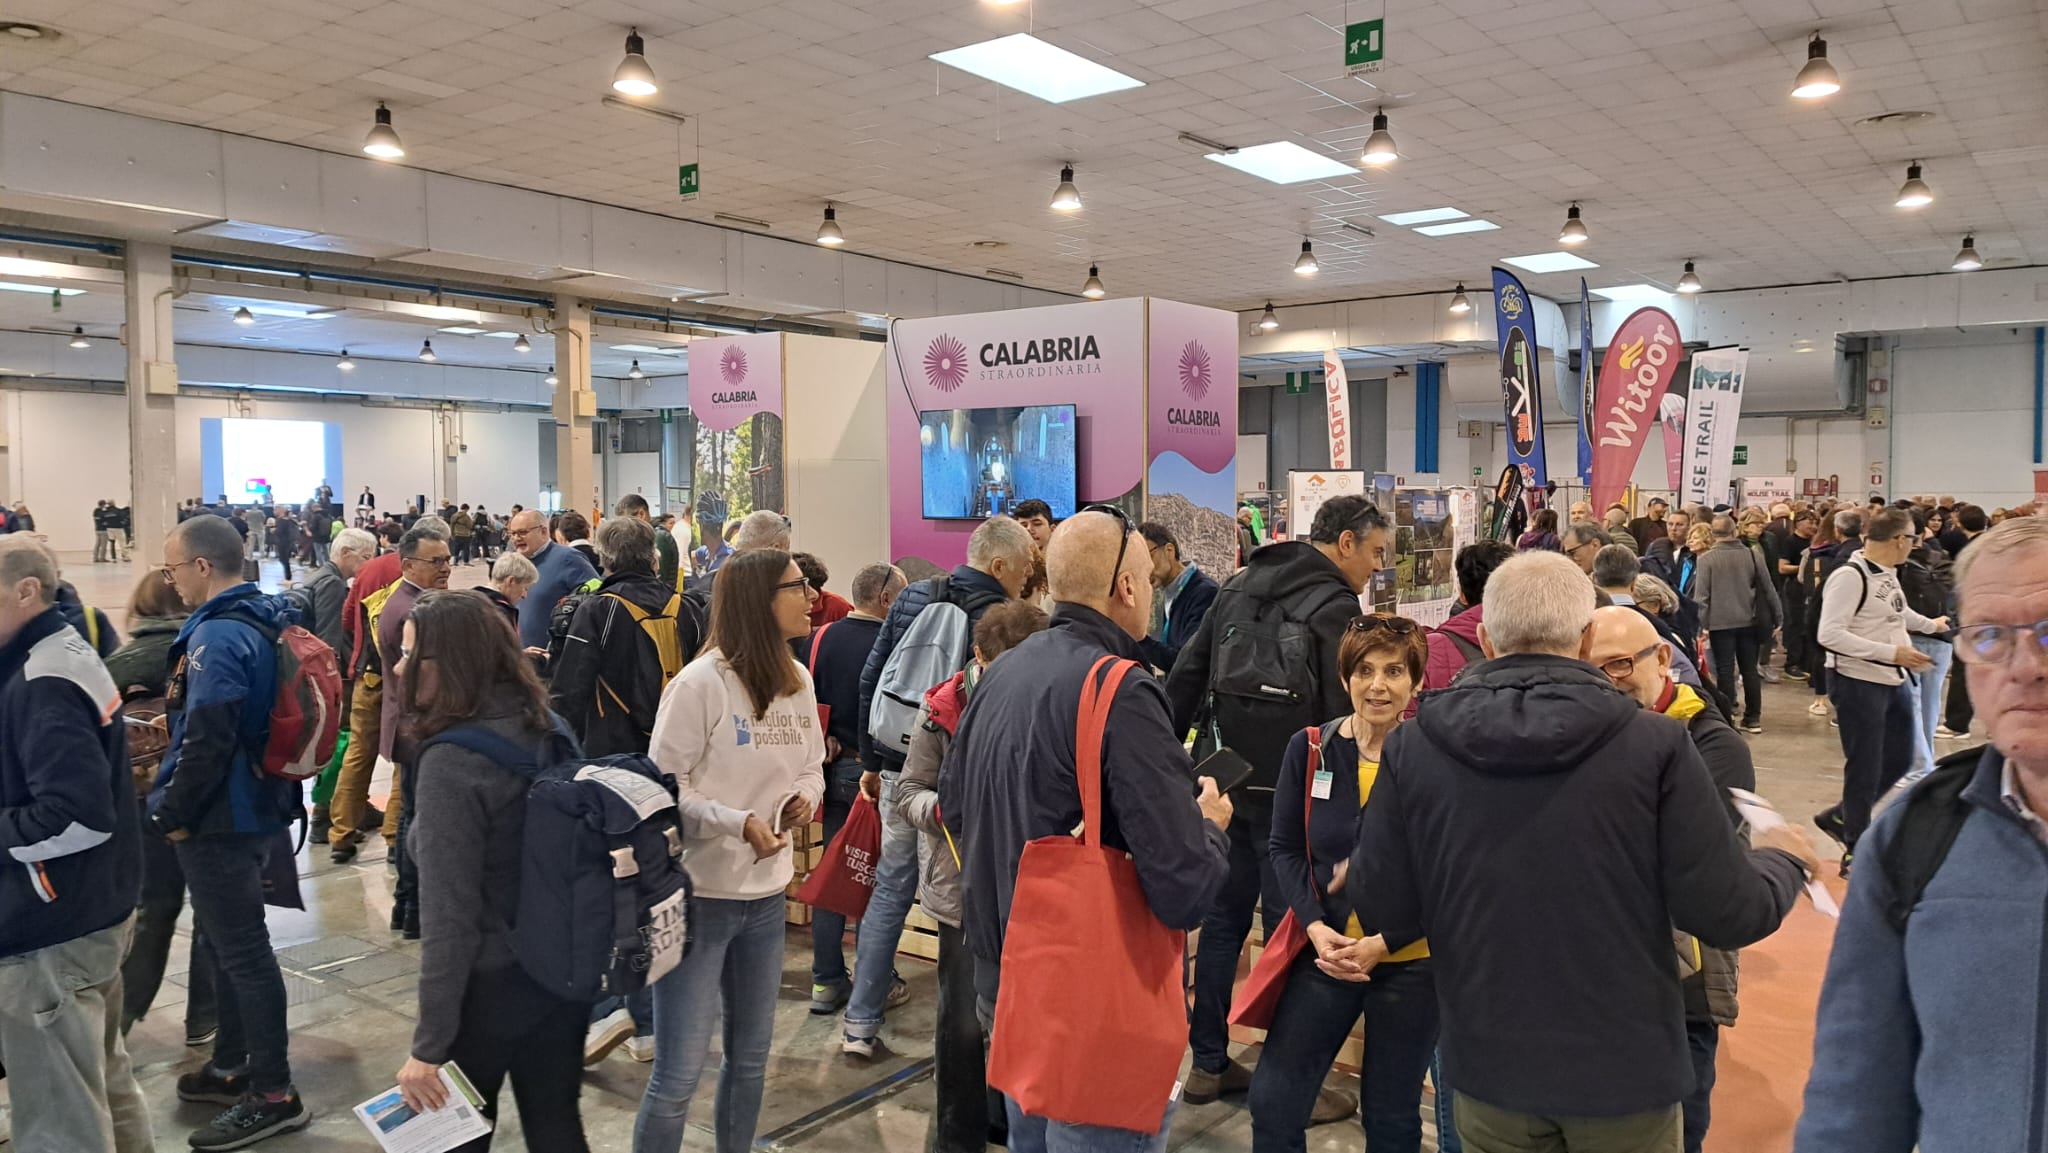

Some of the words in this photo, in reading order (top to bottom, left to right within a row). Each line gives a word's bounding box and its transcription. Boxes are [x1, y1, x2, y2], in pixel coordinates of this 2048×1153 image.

[980, 335, 1101, 367] CALABRIA
[980, 363, 1102, 381] STRAORDINARIA
[1600, 324, 1673, 447] Witoor
[711, 390, 758, 404] CALABRIA
[1167, 408, 1221, 427] CALABRIA
[1694, 400, 1715, 458] TRAIL
[754, 728, 803, 750] possibile
